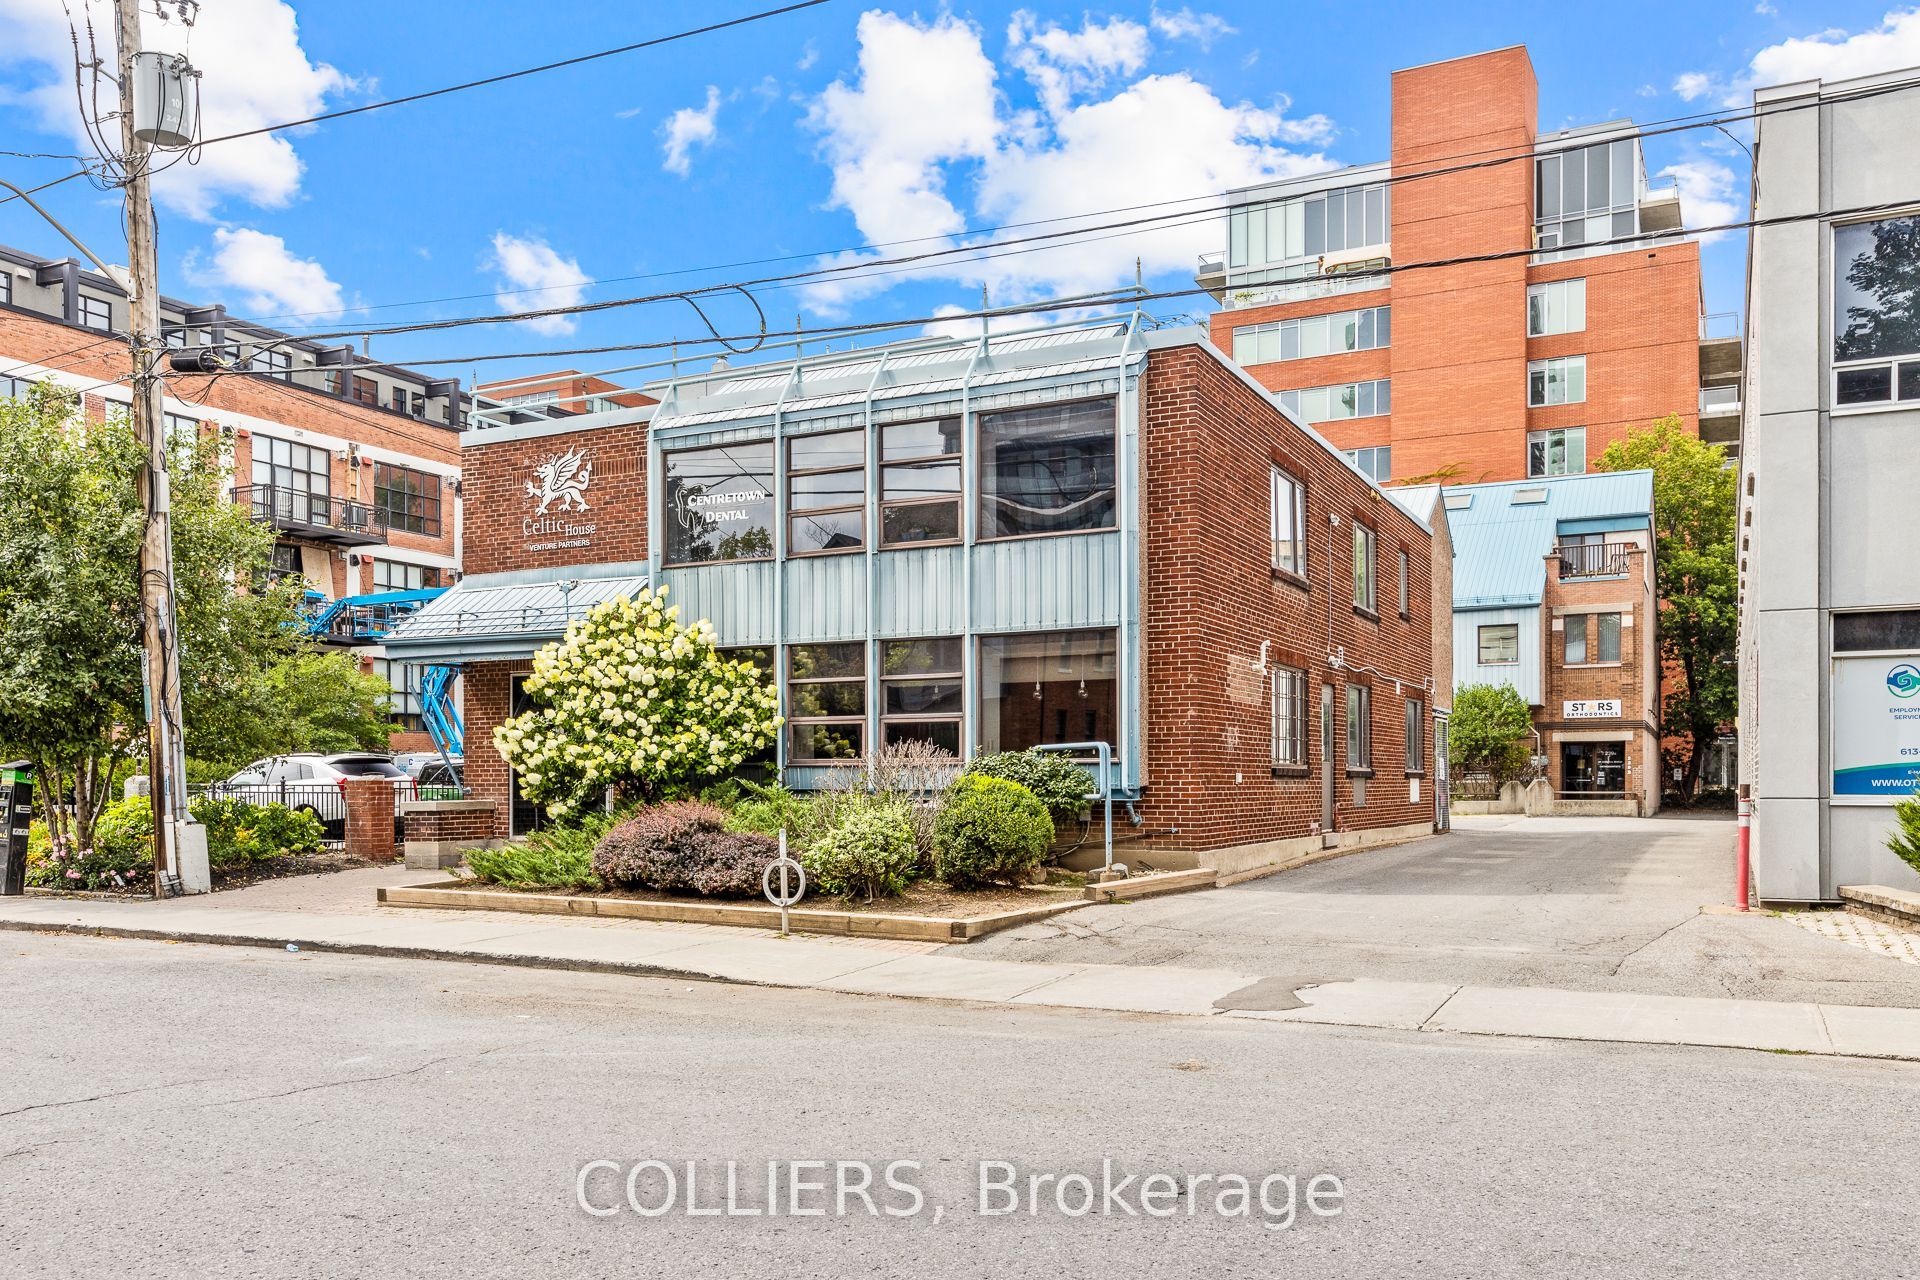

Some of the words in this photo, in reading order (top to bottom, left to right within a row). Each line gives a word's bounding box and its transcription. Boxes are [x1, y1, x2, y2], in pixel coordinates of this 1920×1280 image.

[687, 490, 765, 507] CENTRETOWN
[705, 509, 749, 523] DENTAL
[523, 516, 565, 535] Celtic
[565, 523, 596, 536] House
[529, 541, 558, 552] VENTURE
[558, 538, 591, 550] PARTNERS
